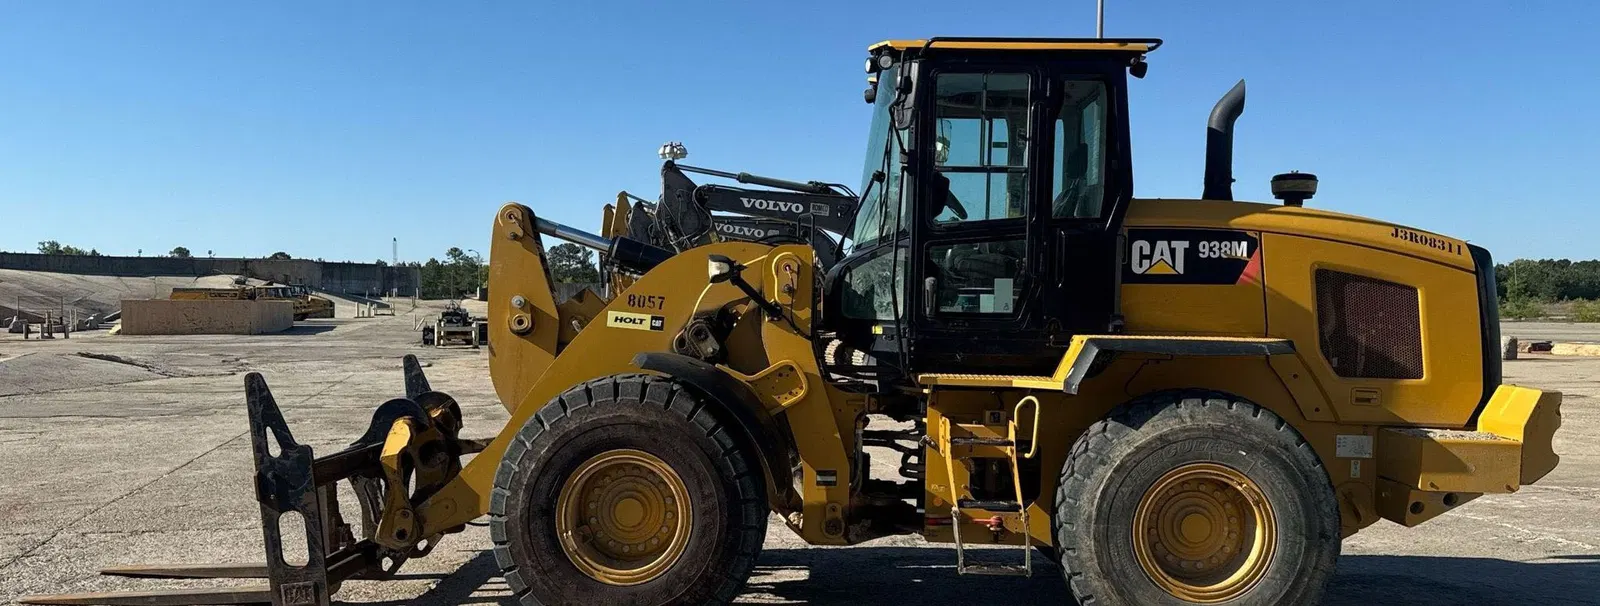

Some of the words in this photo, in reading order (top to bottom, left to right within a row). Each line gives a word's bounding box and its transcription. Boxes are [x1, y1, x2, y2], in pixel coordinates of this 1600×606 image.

[740, 197, 804, 213] VOLVO
[714, 222, 765, 238] VOLVO
[1391, 227, 1462, 255] J3R08311
[1131, 240, 1189, 274] CAT
[1198, 241, 1248, 258] 938M
[628, 293, 665, 310] 8057
[614, 316, 646, 325] HOLT
